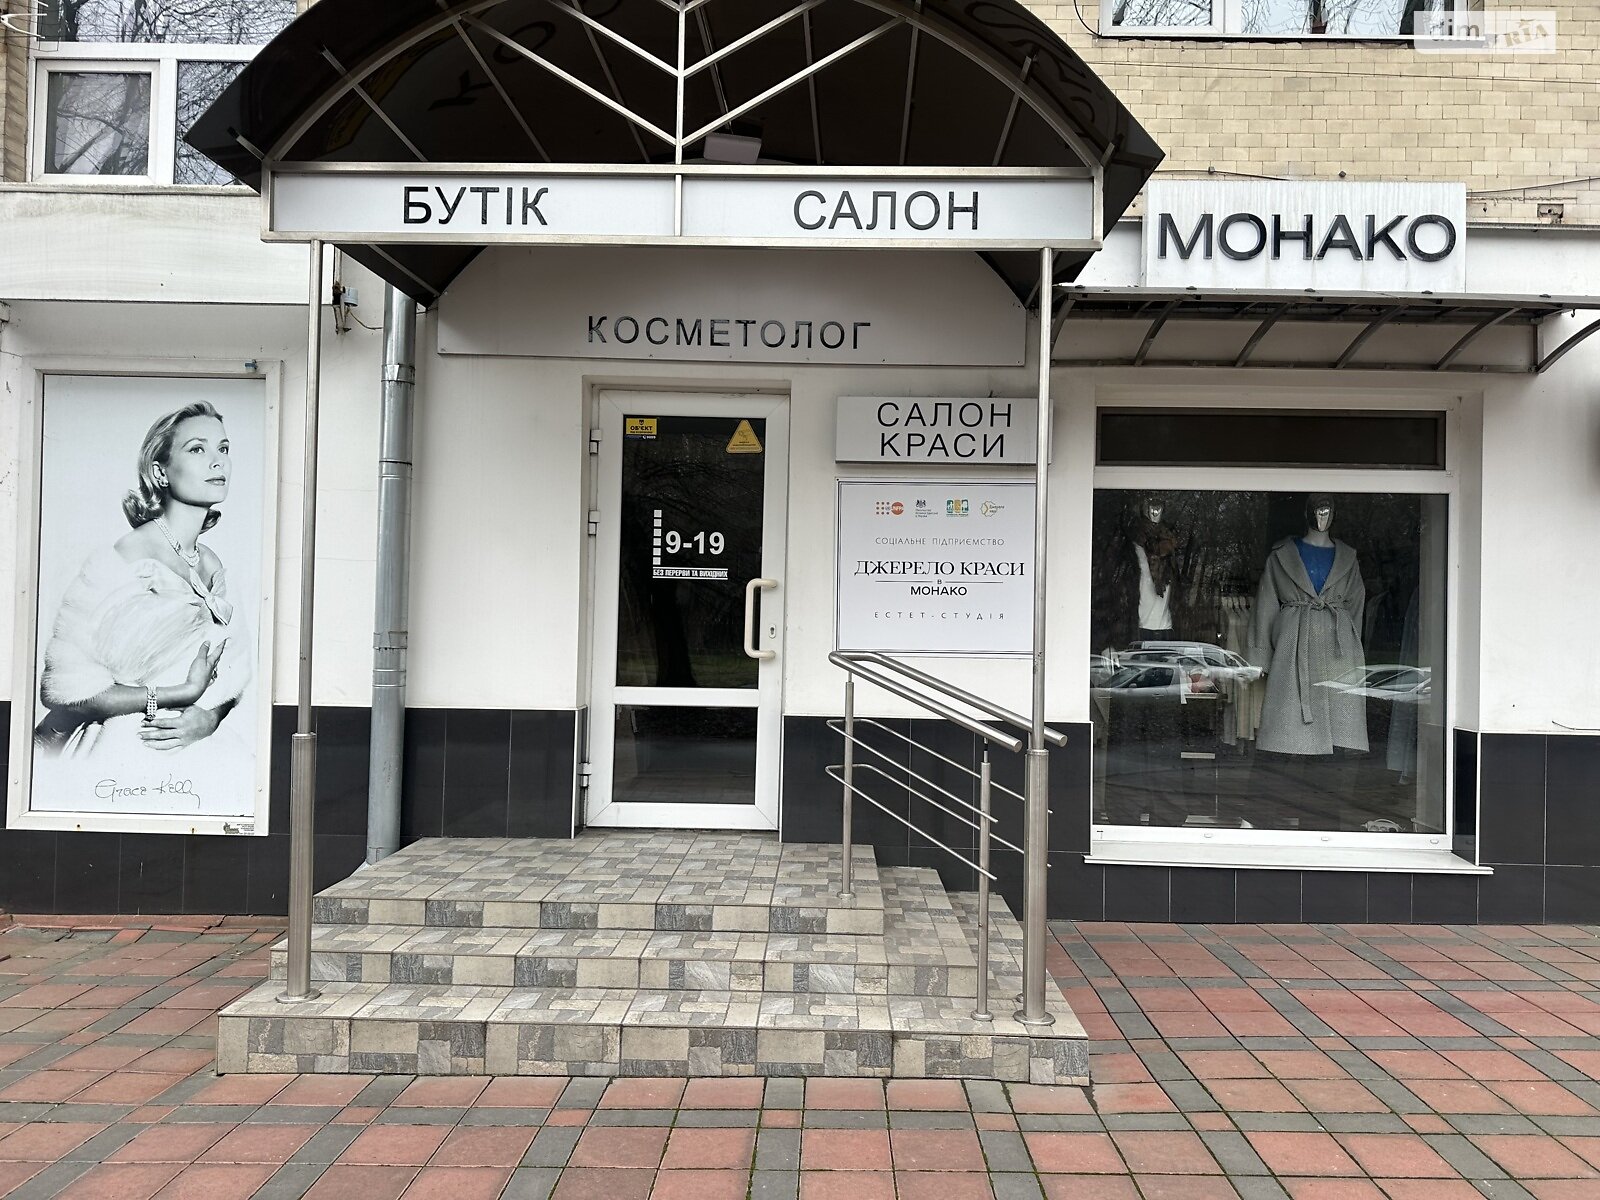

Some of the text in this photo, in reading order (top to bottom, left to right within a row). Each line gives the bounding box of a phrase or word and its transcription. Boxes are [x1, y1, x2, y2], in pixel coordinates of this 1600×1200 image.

[403, 186, 549, 225] БУТІК
[793, 189, 979, 230] САЛОН
[1157, 212, 1457, 262] МОНАКО
[587, 314, 871, 350] КОСМЕТОЛОГ
[877, 402, 1012, 428] САЛОН
[880, 432, 1005, 458] КРАСИ
[665, 530, 726, 555] 9-19
[875, 537, 1005, 546] СОЦІАЛЬНЕ ПІДПРИЄМСТВО
[665, 569, 691, 577] ПЕРЕРВИ
[699, 570, 728, 578] ВИХОДНИХ
[854, 560, 1025, 577] ДЖЕРЕЛО КРАСИ
[910, 586, 968, 596] МОНАКО
[874, 611, 1005, 620] ЕСТЕТ-СТУДІЯ
[95, 773, 201, 809] Grace Kelly
